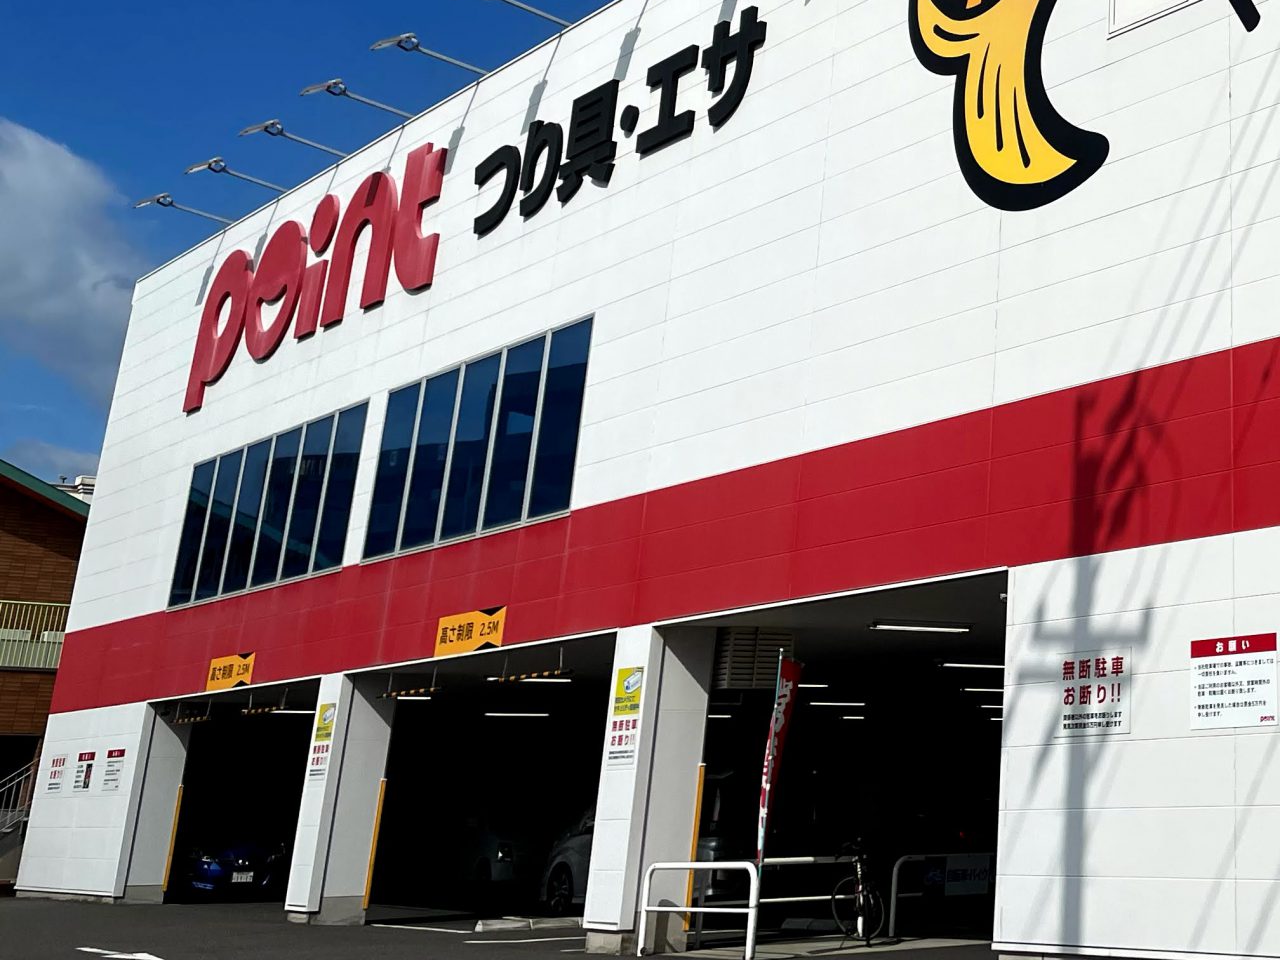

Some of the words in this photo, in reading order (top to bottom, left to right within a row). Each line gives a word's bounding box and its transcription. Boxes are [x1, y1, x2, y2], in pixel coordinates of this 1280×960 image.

[473, 6, 767, 237] つり具・エサ
[182, 142, 447, 415] point
[439, 622, 474, 645] 高さ制限
[1062, 656, 1124, 680] 無断駐車
[1063, 683, 1121, 705] お断り!!
